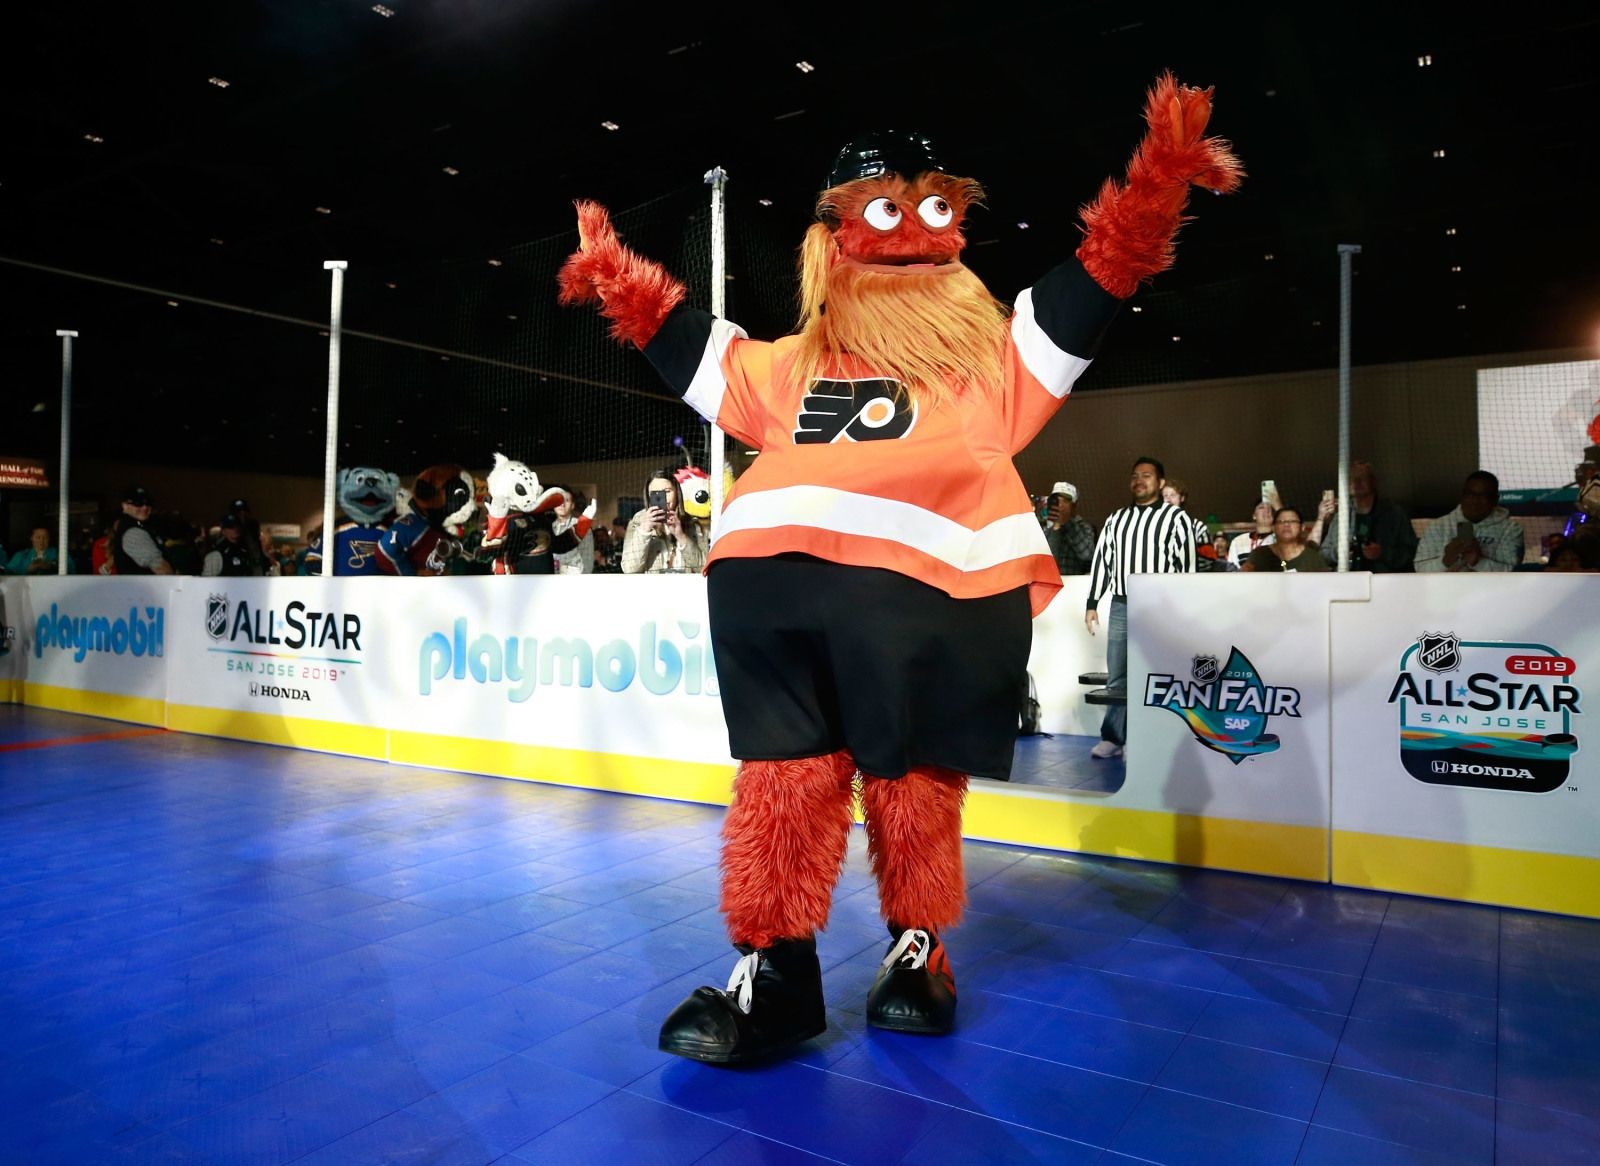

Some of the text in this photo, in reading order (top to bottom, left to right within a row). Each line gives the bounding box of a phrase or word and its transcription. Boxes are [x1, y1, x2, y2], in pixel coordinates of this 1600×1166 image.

[35, 602, 164, 663] playmobil
[1426, 642, 1454, 664] NHL
[226, 659, 338, 682] SAN JOSE 2019
[1225, 670, 1253, 678] 2019
[1514, 660, 1567, 672] 2019
[260, 684, 312, 702] HONDA
[1145, 674, 1300, 717] FAN FAIR
[1224, 717, 1251, 730] SAP
[1420, 712, 1546, 730] SAN JOSE
[1450, 762, 1536, 780] HONDA
